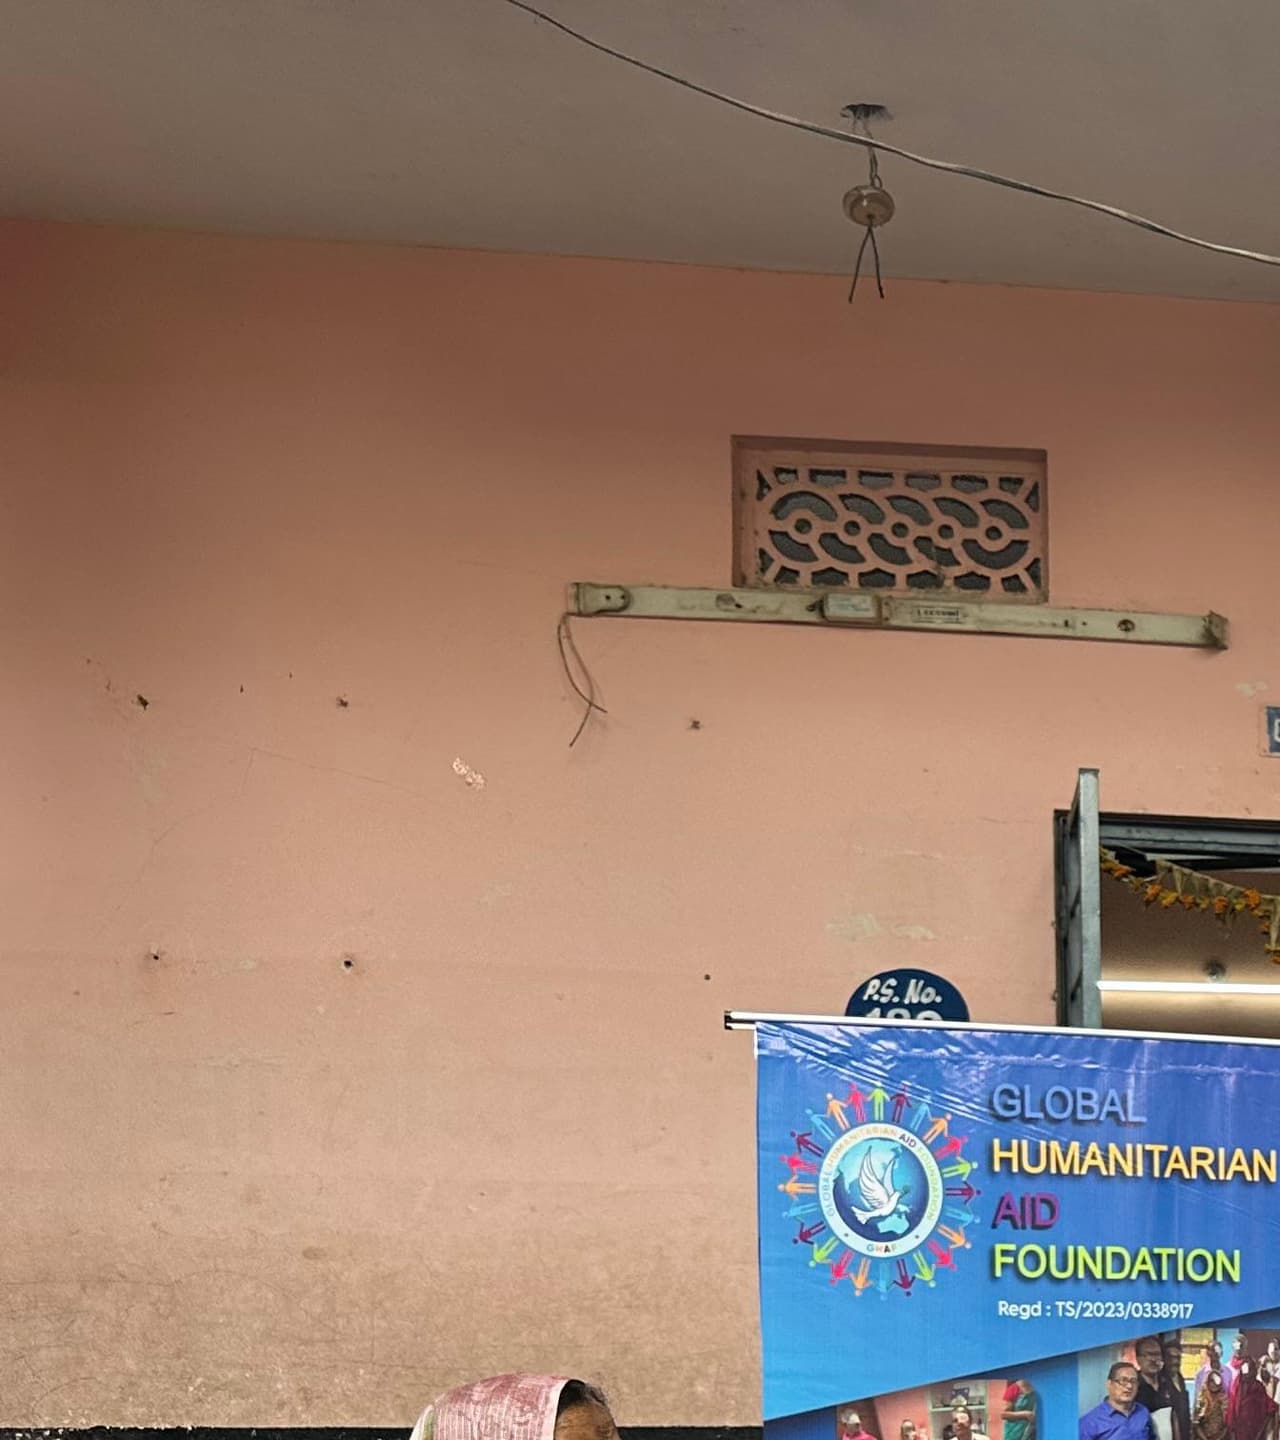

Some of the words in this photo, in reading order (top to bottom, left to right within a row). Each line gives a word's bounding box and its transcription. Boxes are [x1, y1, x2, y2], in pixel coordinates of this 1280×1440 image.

[863, 978, 899, 1004] P.S.
[904, 979, 942, 1004] No.
[992, 1083, 1147, 1123] GLOBAL
[898, 1133, 917, 1149] AID
[992, 1138, 1277, 1183] HUMANITARIAN
[992, 1191, 1061, 1229] AID
[993, 1243, 1241, 1283] FOUNDATION
[998, 1301, 1042, 1318] Regd
[1055, 1302, 1194, 1319] TS/2023/0338917
